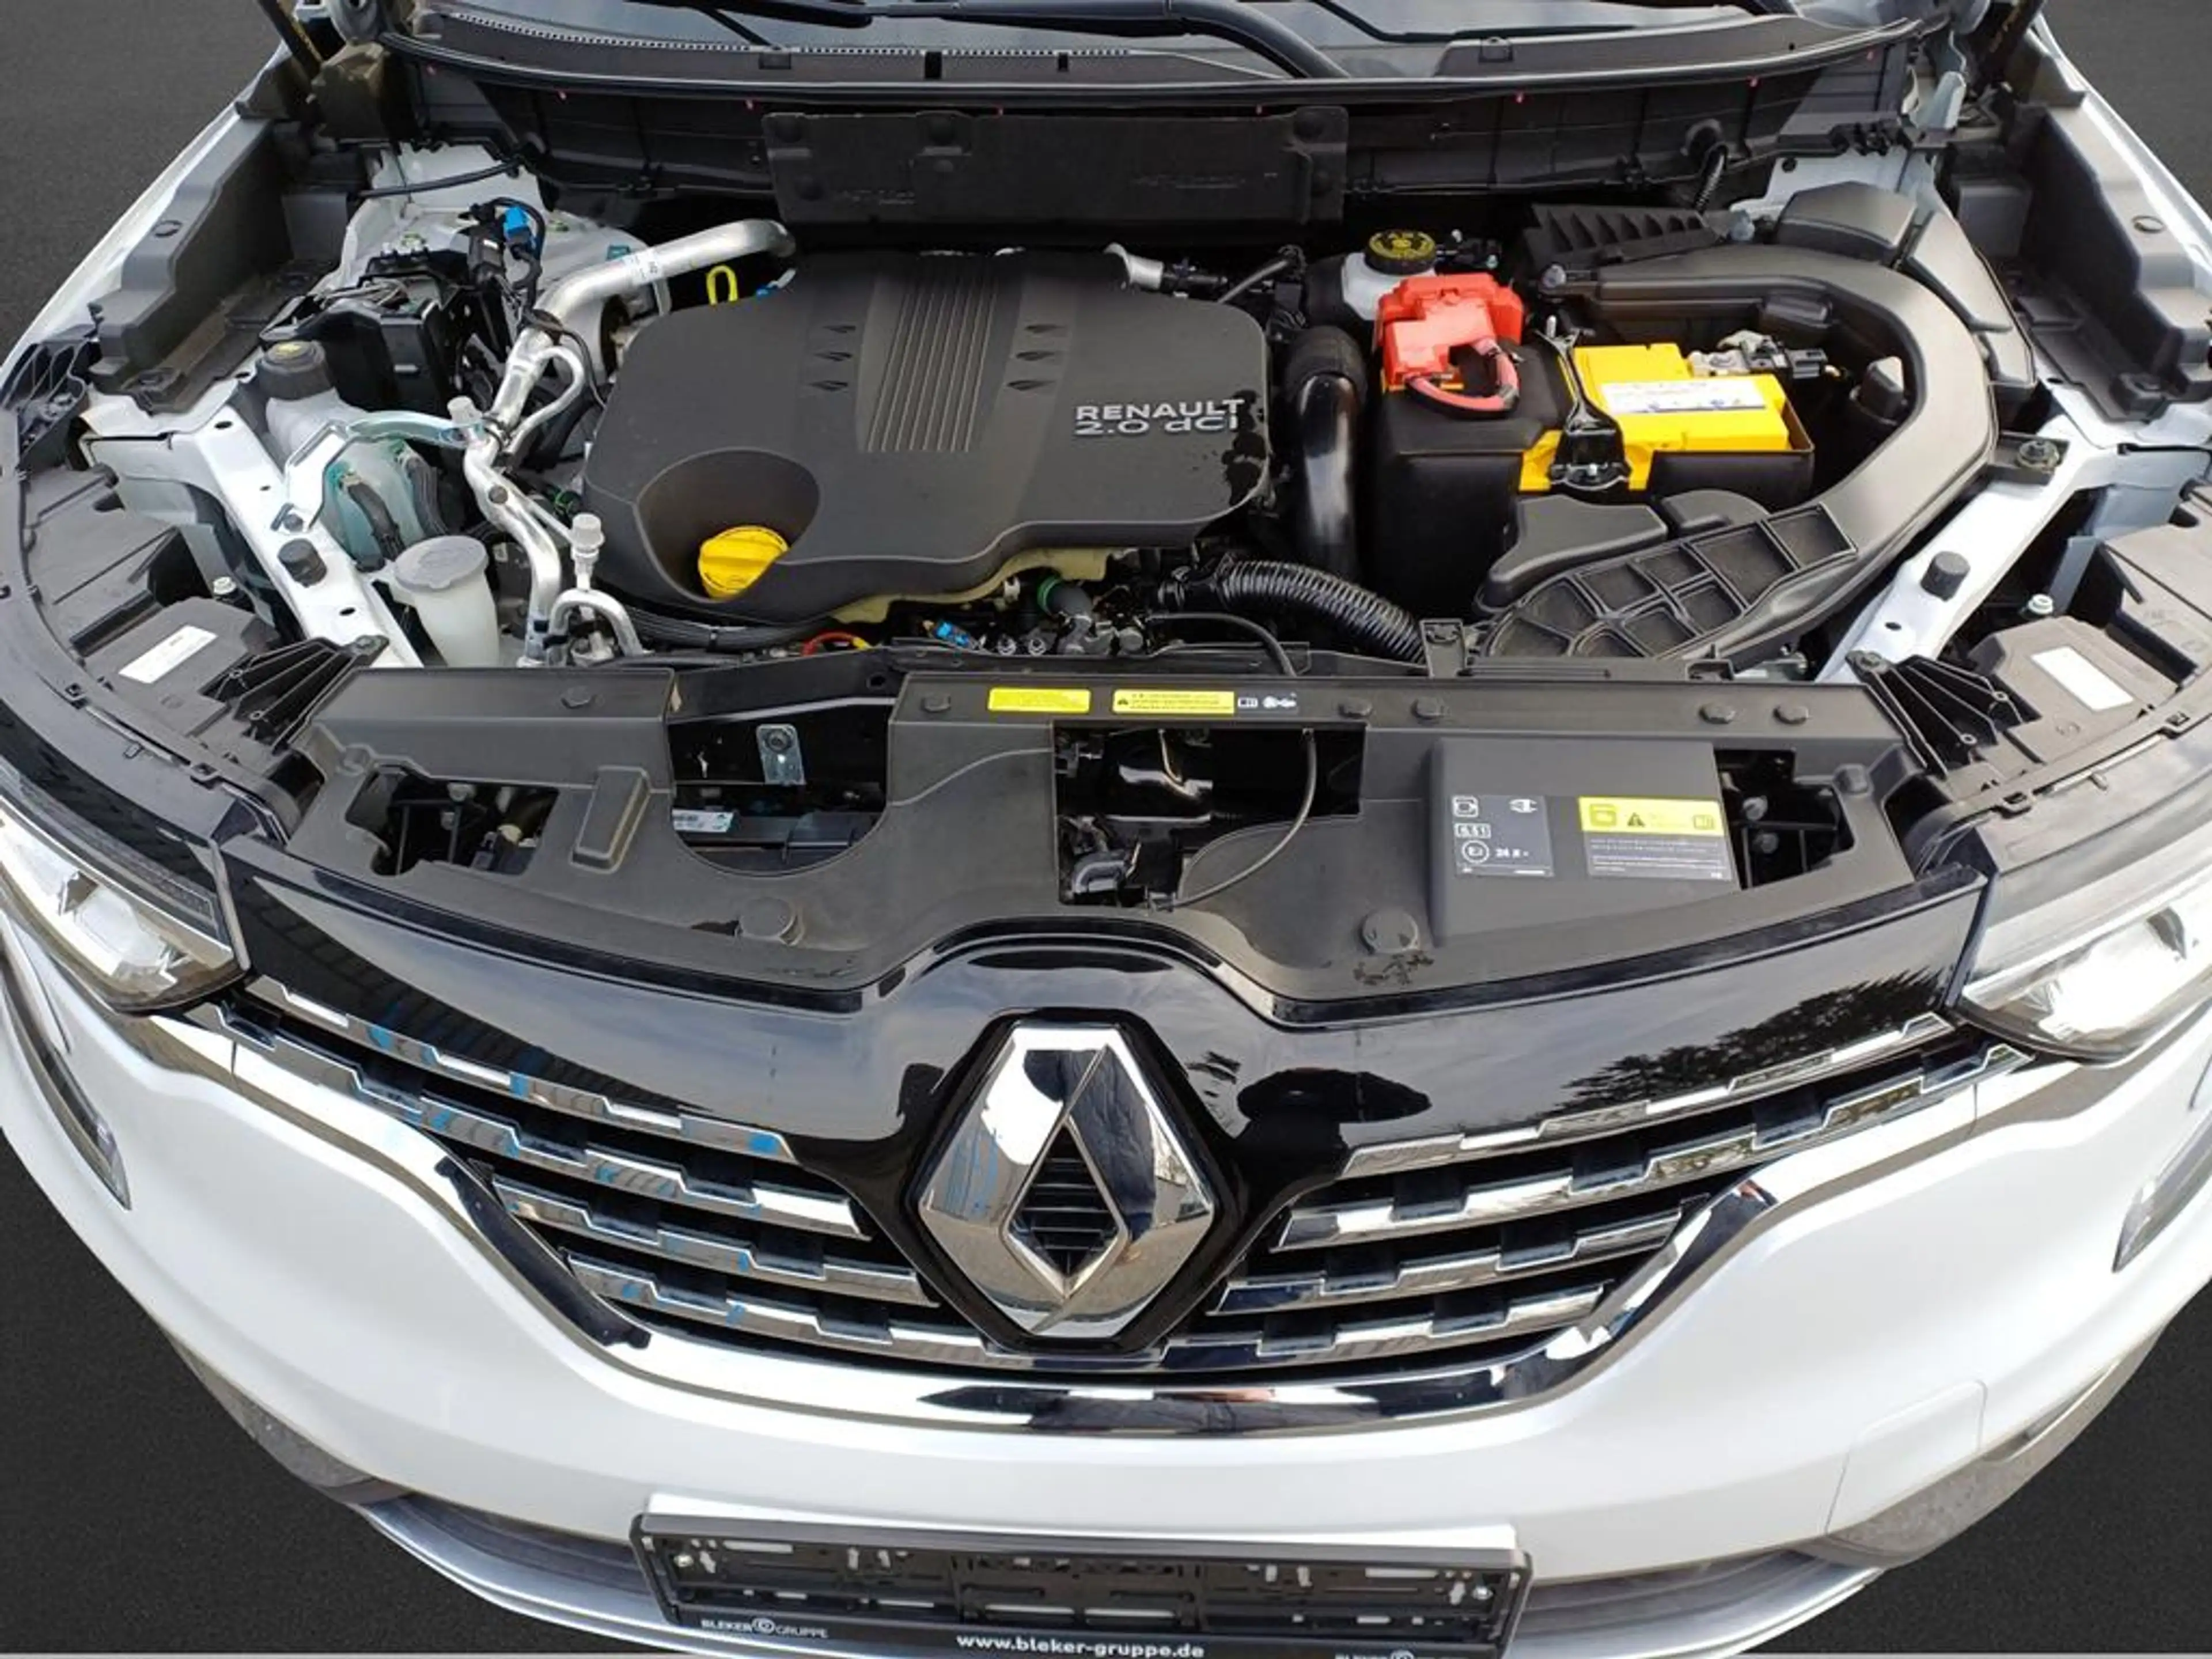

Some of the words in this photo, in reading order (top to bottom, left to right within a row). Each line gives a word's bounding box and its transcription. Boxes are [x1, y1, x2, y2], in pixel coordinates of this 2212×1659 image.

[1076, 399, 1245, 420] RENAULT
[1075, 419, 1150, 435] 2.0
[956, 1634, 1205, 1658] www.bleker-gruppe.de
